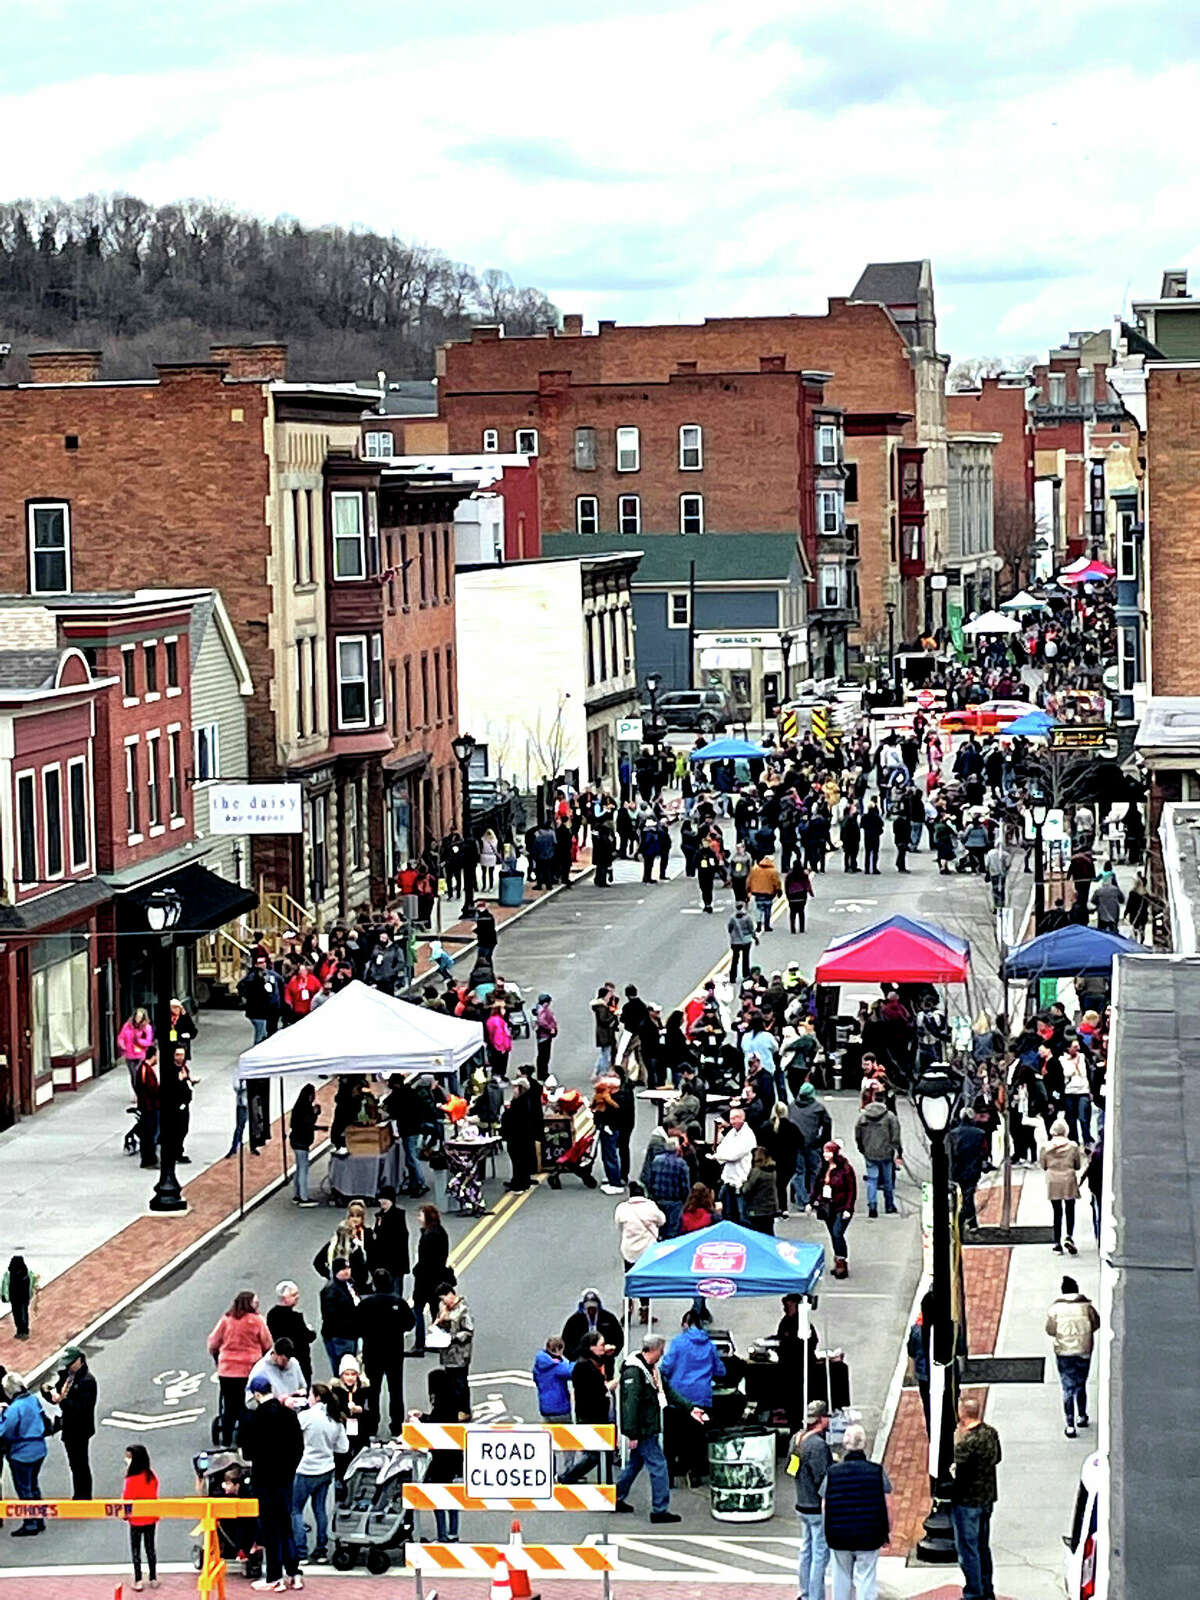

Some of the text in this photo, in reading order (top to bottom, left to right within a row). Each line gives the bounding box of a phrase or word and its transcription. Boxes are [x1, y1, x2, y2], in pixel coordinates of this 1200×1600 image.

[213, 795, 297, 812] the daisy
[481, 1443, 535, 1460] ROAD
[471, 1469, 547, 1487] CLOSED
[5, 1503, 59, 1517] COHOES
